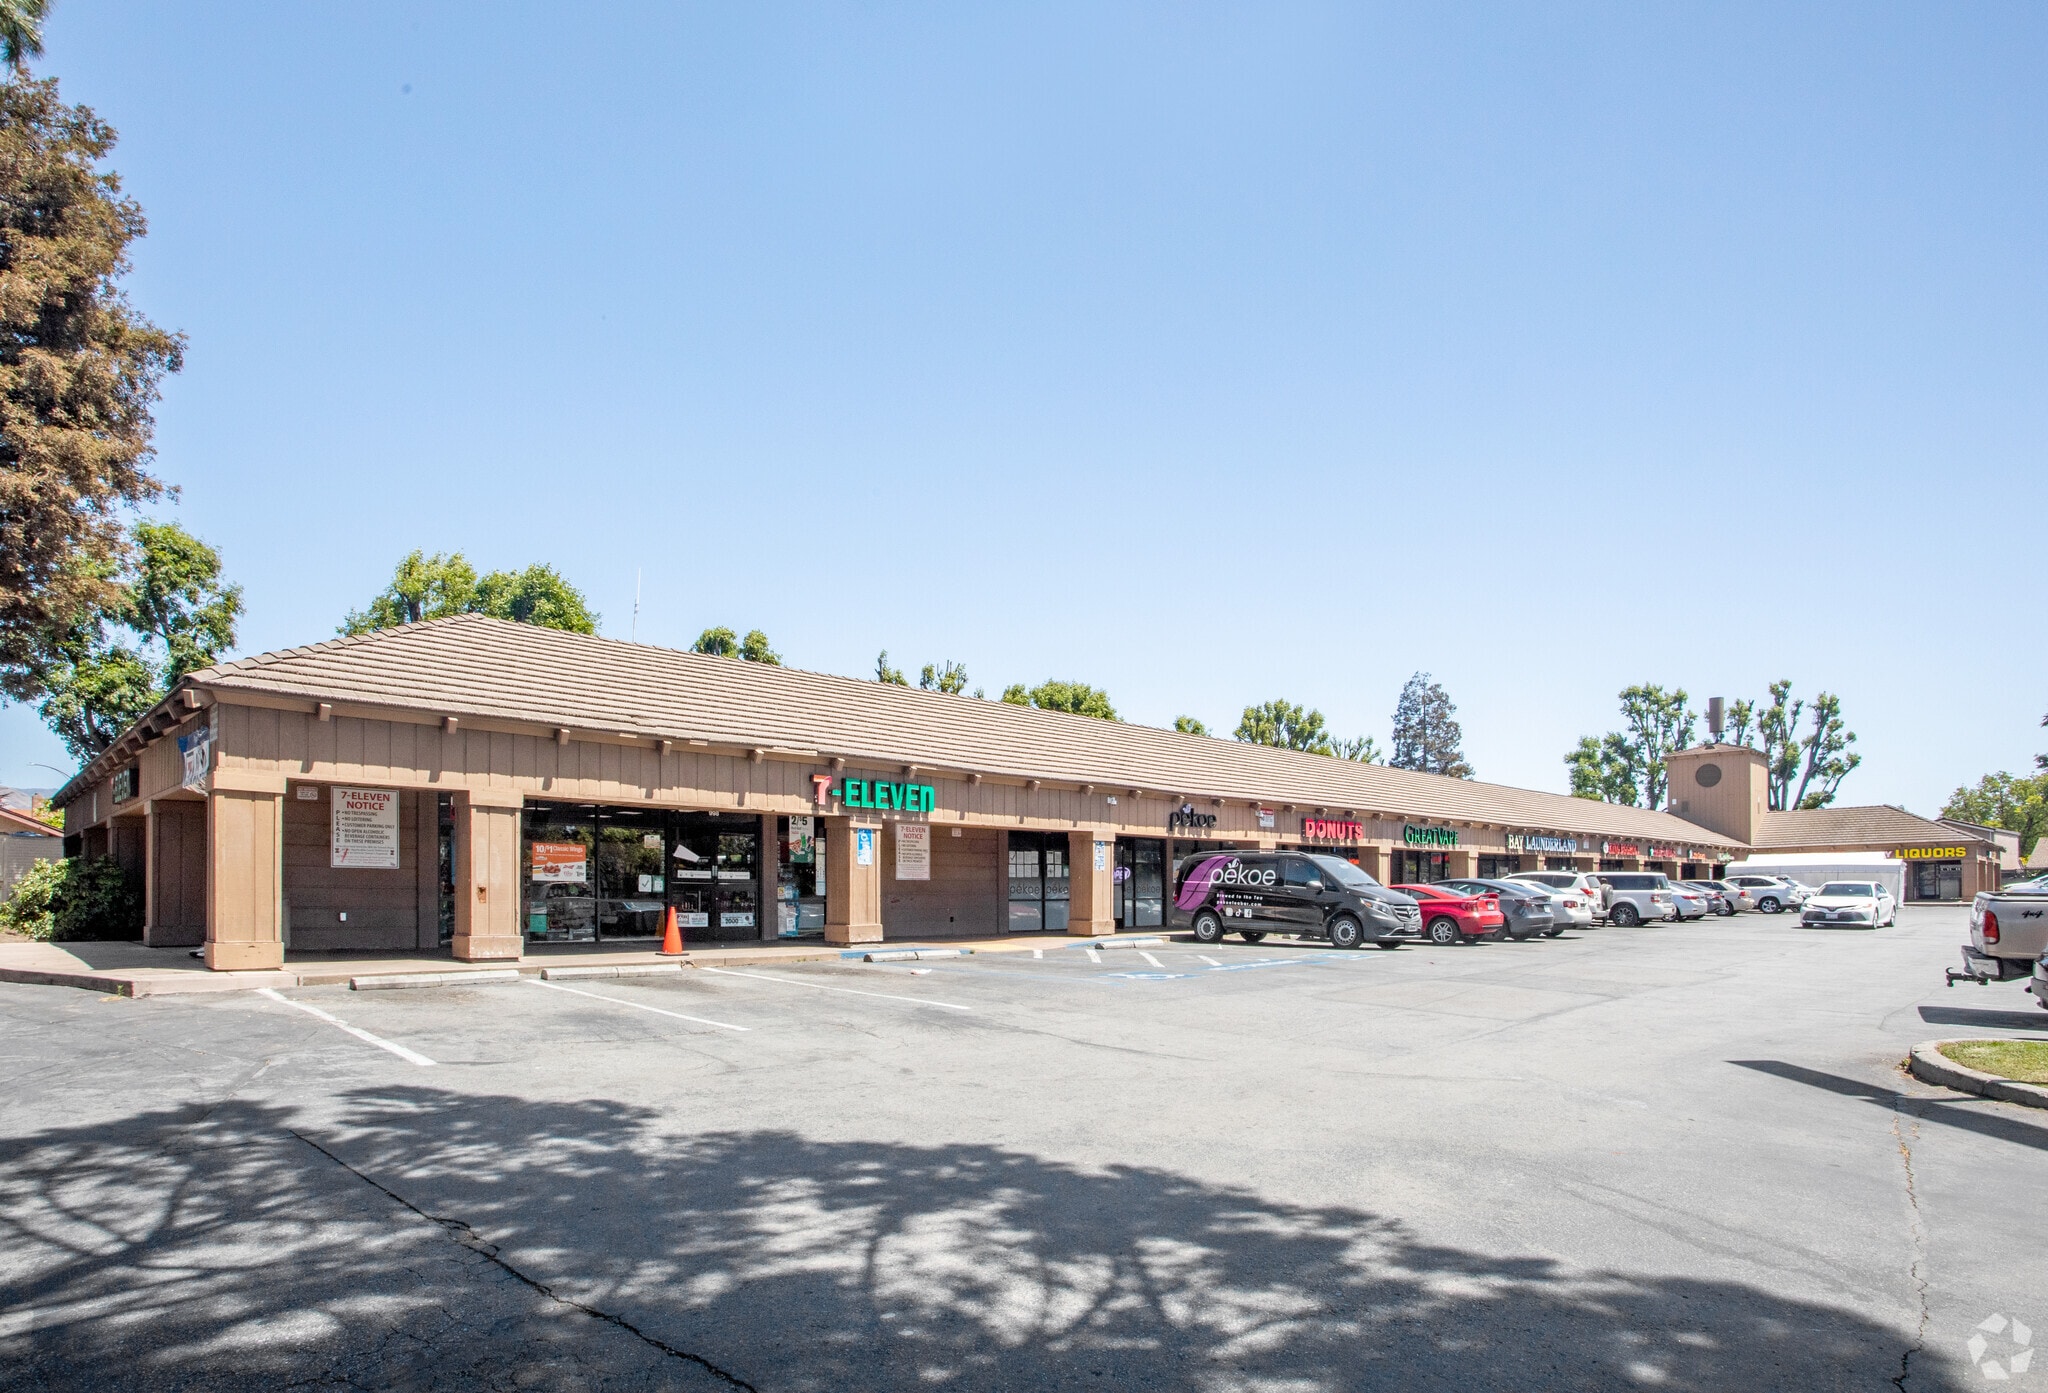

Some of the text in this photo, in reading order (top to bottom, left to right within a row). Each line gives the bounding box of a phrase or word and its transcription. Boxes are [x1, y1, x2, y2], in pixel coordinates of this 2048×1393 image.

[341, 791, 390, 801] 7-ELEVEN
[346, 801, 384, 810] NOTICE
[1169, 807, 1217, 831] pekoe
[1305, 818, 1363, 840] DONUTS
[1404, 824, 1459, 846] GREAT VAPE
[1507, 834, 1577, 853] BAY LAUNDERLAND
[1895, 847, 1967, 859] LIQUORS
[1208, 862, 1277, 888] pekoe
